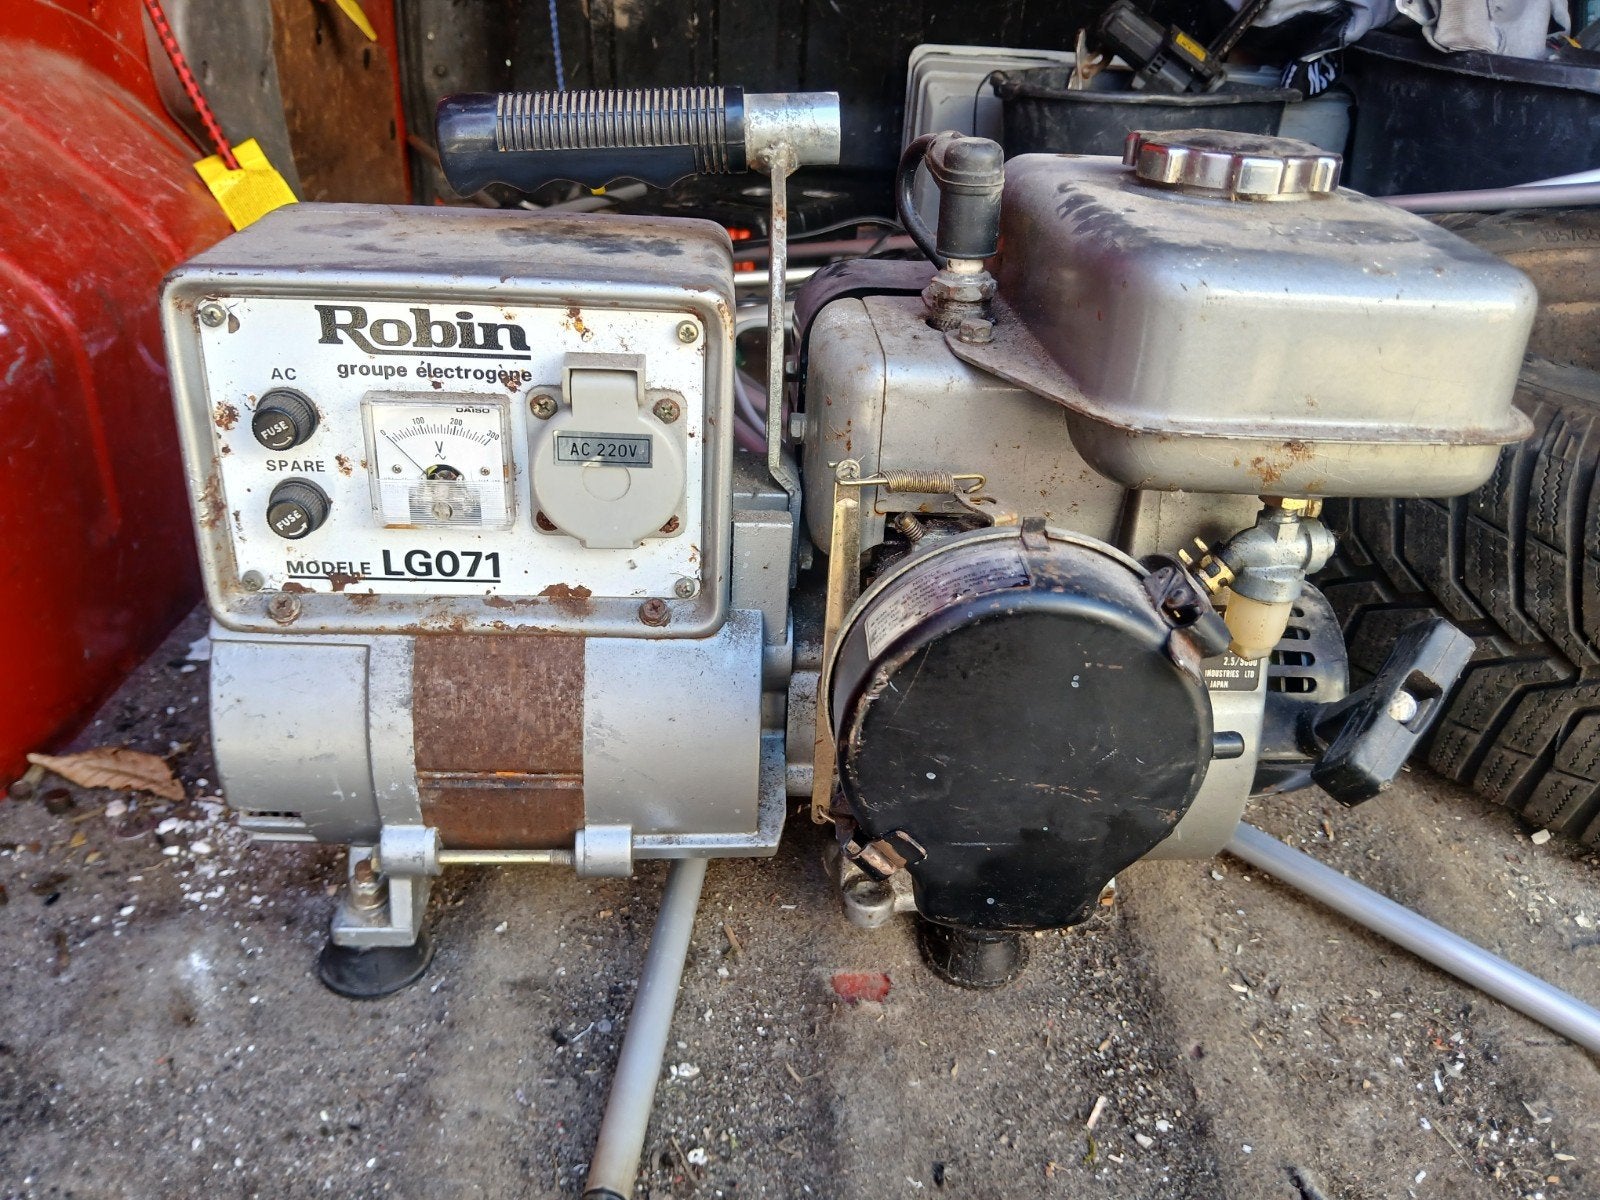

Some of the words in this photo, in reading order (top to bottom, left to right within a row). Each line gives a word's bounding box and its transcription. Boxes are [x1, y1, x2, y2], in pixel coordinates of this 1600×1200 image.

[314, 304, 531, 354] Robin
[271, 367, 297, 381] AC
[337, 363, 408, 379] groupe
[416, 361, 533, 384] électrogène
[412, 416, 425, 425] 100
[449, 417, 463, 427] 200
[260, 420, 289, 441] FUSE
[379, 429, 387, 437] 0
[486, 429, 500, 441] 300
[434, 440, 444, 454] V
[570, 442, 590, 456] AC
[597, 443, 637, 458] 220V
[266, 459, 326, 473] SPARE
[275, 509, 302, 531] FUSE
[286, 560, 372, 576] MODELE
[382, 549, 501, 578] LG071
[1244, 669, 1255, 679] LTD
[1209, 680, 1229, 689] JAPAN
